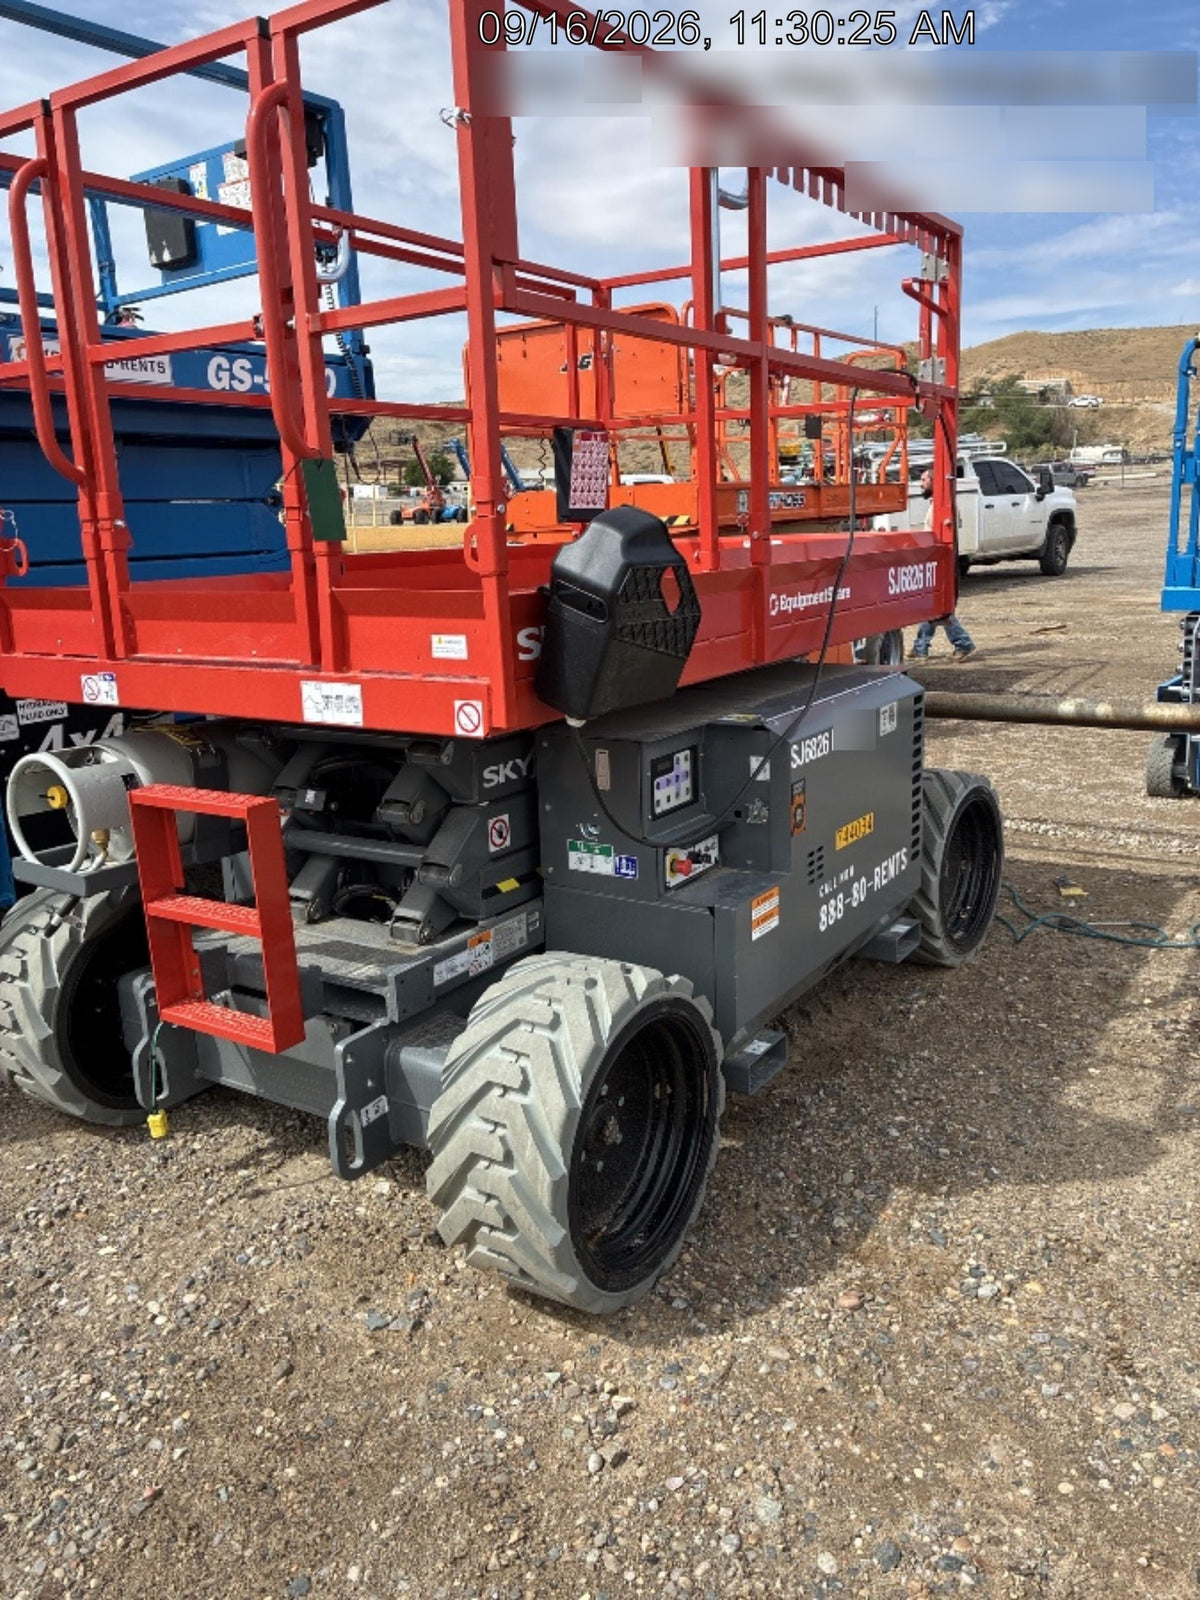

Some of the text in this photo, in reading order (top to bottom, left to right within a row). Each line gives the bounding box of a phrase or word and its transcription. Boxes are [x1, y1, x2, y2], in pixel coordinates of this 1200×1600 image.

[889, 561, 938, 595] SJ6826 RT
[780, 586, 851, 614] EquipmentSare
[790, 731, 830, 769] SJ6826
[819, 847, 908, 933] 888-80-RENTS
